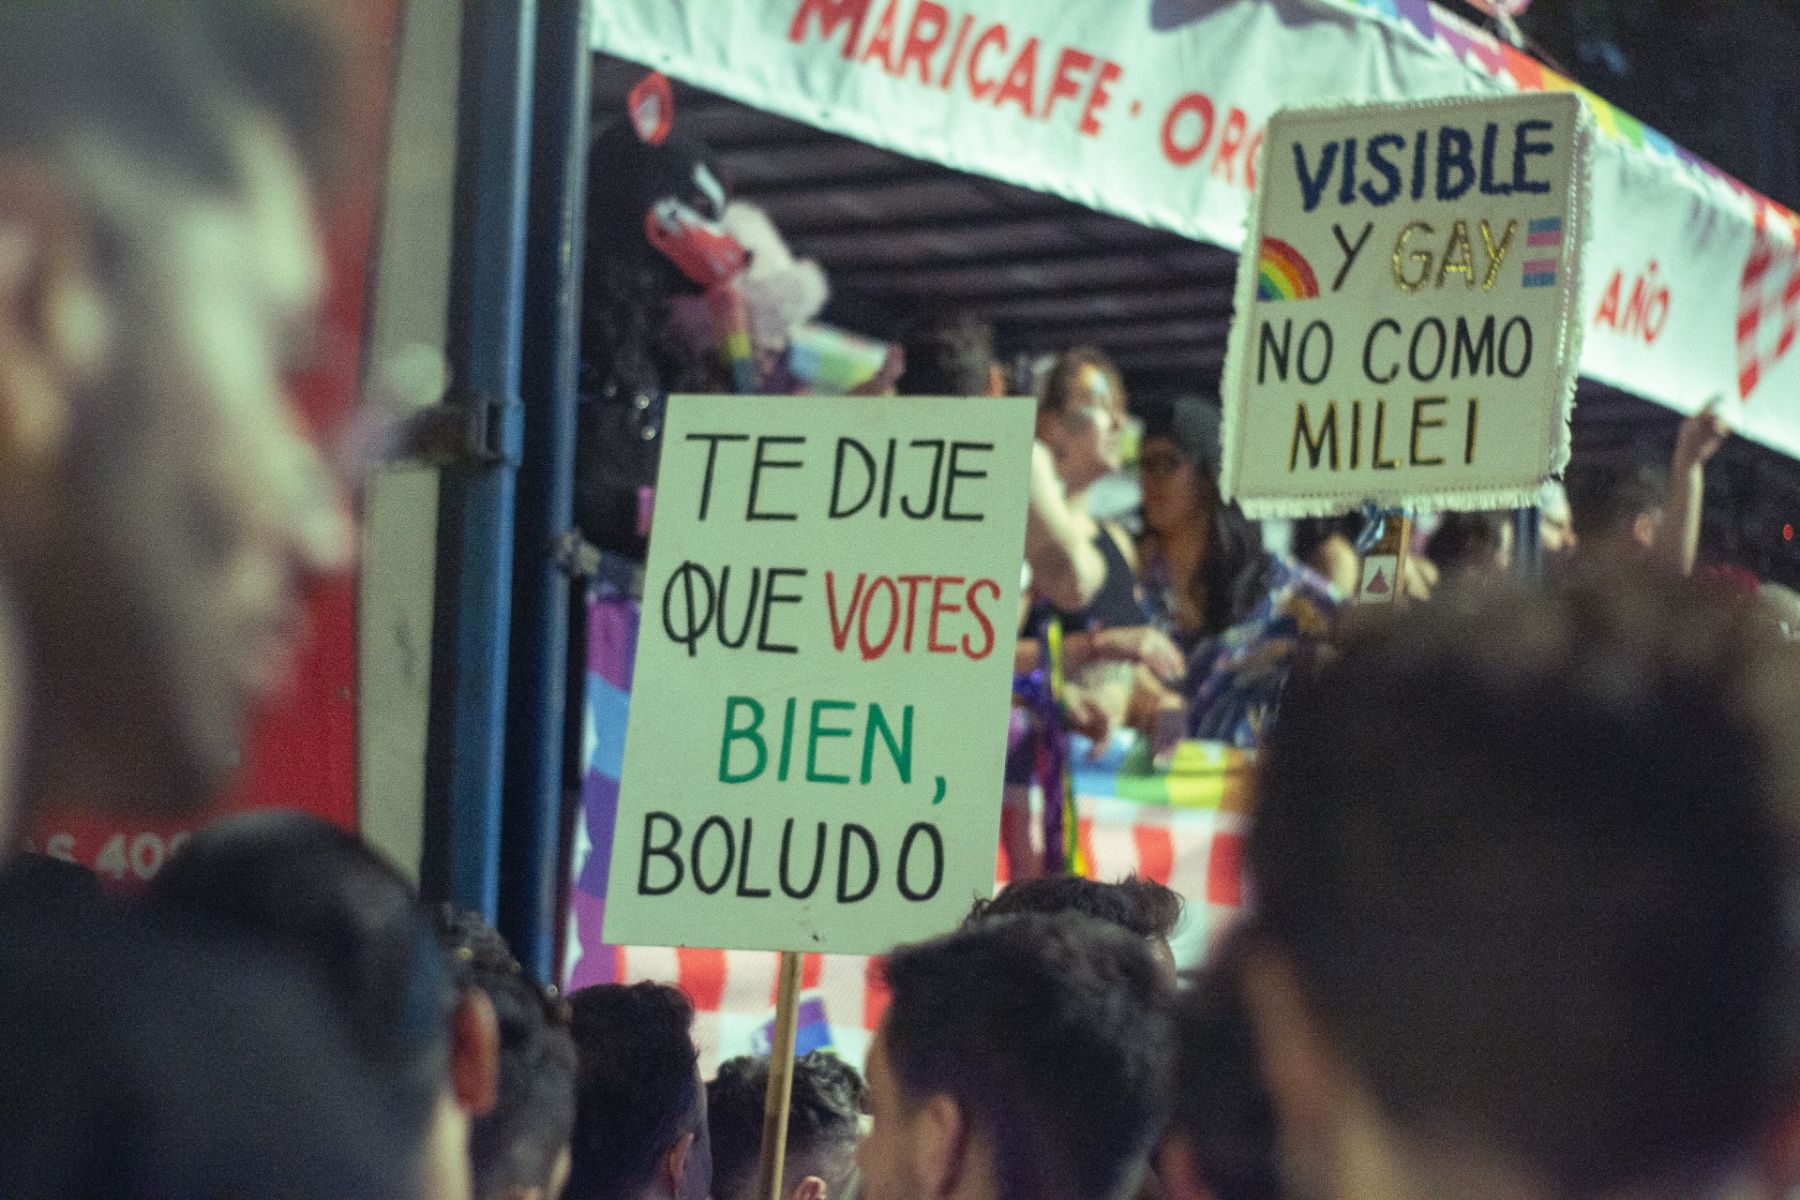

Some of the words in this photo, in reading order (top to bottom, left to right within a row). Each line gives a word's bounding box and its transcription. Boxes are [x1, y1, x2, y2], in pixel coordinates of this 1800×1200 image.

[1292, 119, 1554, 212] VISIBLE
[1332, 221, 1373, 292] Y
[1393, 219, 1518, 293] GAY
[1257, 318, 1333, 385] NO
[1362, 315, 1533, 384] COMO
[685, 434, 806, 521] TE
[828, 437, 995, 522] DIJE
[1289, 397, 1479, 473] MILEI
[662, 560, 807, 657] QUE
[824, 570, 1001, 661] VOTES
[718, 696, 946, 805] BIEN,
[637, 811, 944, 904] BOLUDO
